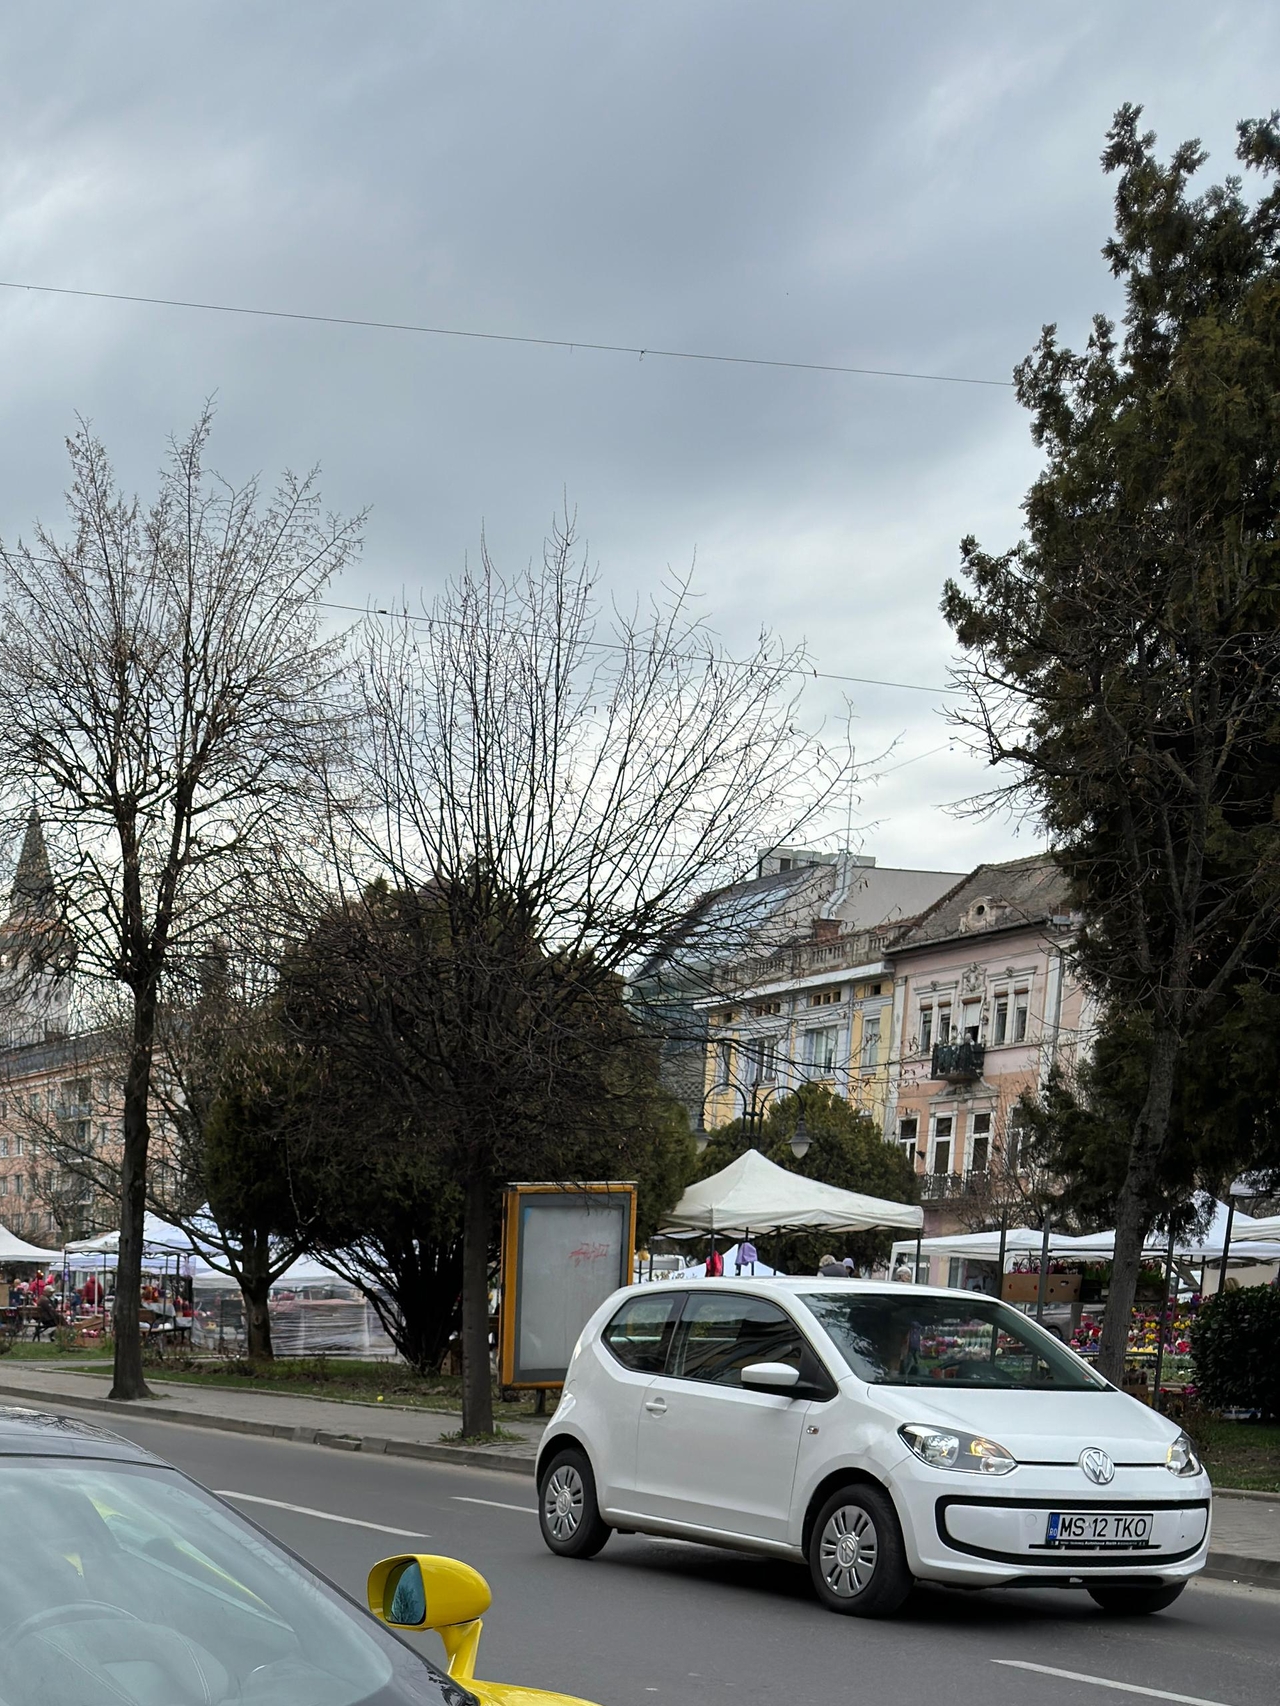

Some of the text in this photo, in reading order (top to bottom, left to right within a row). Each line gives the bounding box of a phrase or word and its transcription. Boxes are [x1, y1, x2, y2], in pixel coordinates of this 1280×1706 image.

[1060, 1518, 1147, 1537] MS 12 TKO
